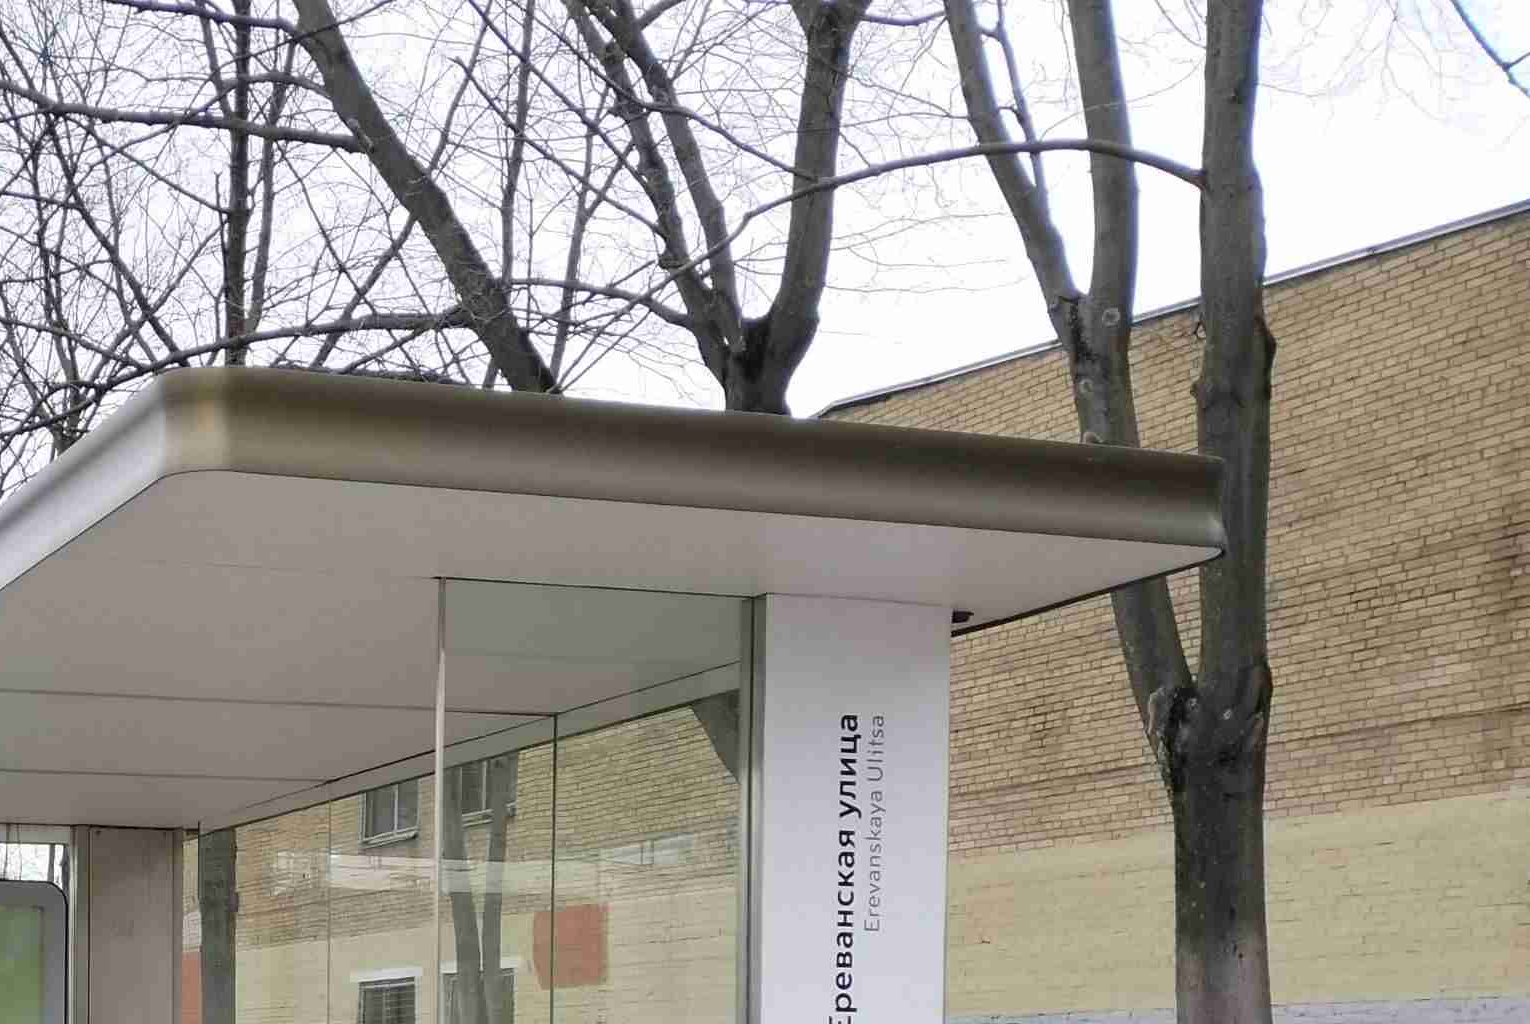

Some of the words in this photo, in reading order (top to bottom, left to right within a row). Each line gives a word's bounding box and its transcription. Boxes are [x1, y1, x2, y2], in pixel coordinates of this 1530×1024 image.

[837, 713, 862, 819] улица
[866, 714, 886, 782] Ulitsa
[864, 790, 887, 932] Erevanskaya
